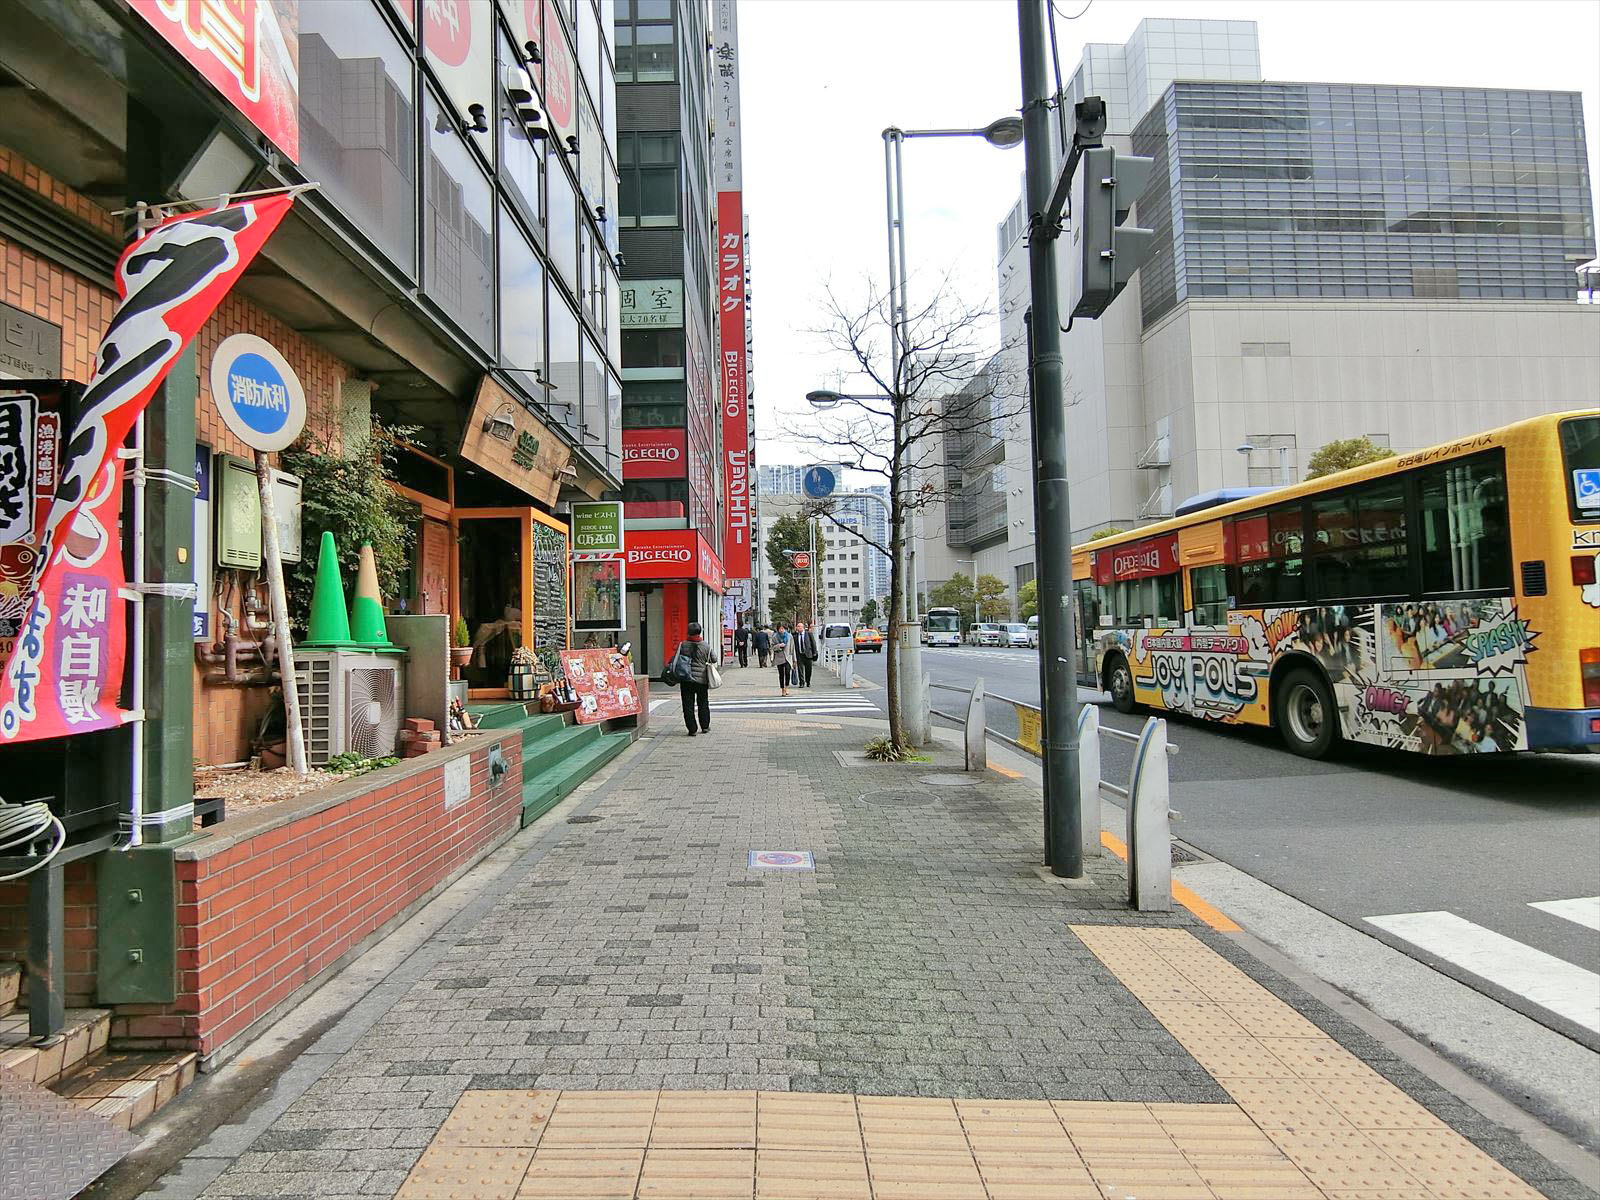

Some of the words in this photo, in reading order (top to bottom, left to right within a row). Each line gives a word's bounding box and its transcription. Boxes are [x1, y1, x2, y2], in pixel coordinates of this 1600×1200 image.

[722, 233, 741, 312] カラオケ
[725, 351, 738, 377] BIG
[231, 373, 287, 413] 消防水利
[727, 379, 740, 417] ECHO
[640, 447, 680, 461] ECHO
[728, 450, 747, 544] ビッグエコー
[628, 550, 653, 563] BIG
[655, 549, 692, 561] ECHO
[1136, 654, 1268, 699] JOYPOLIS
